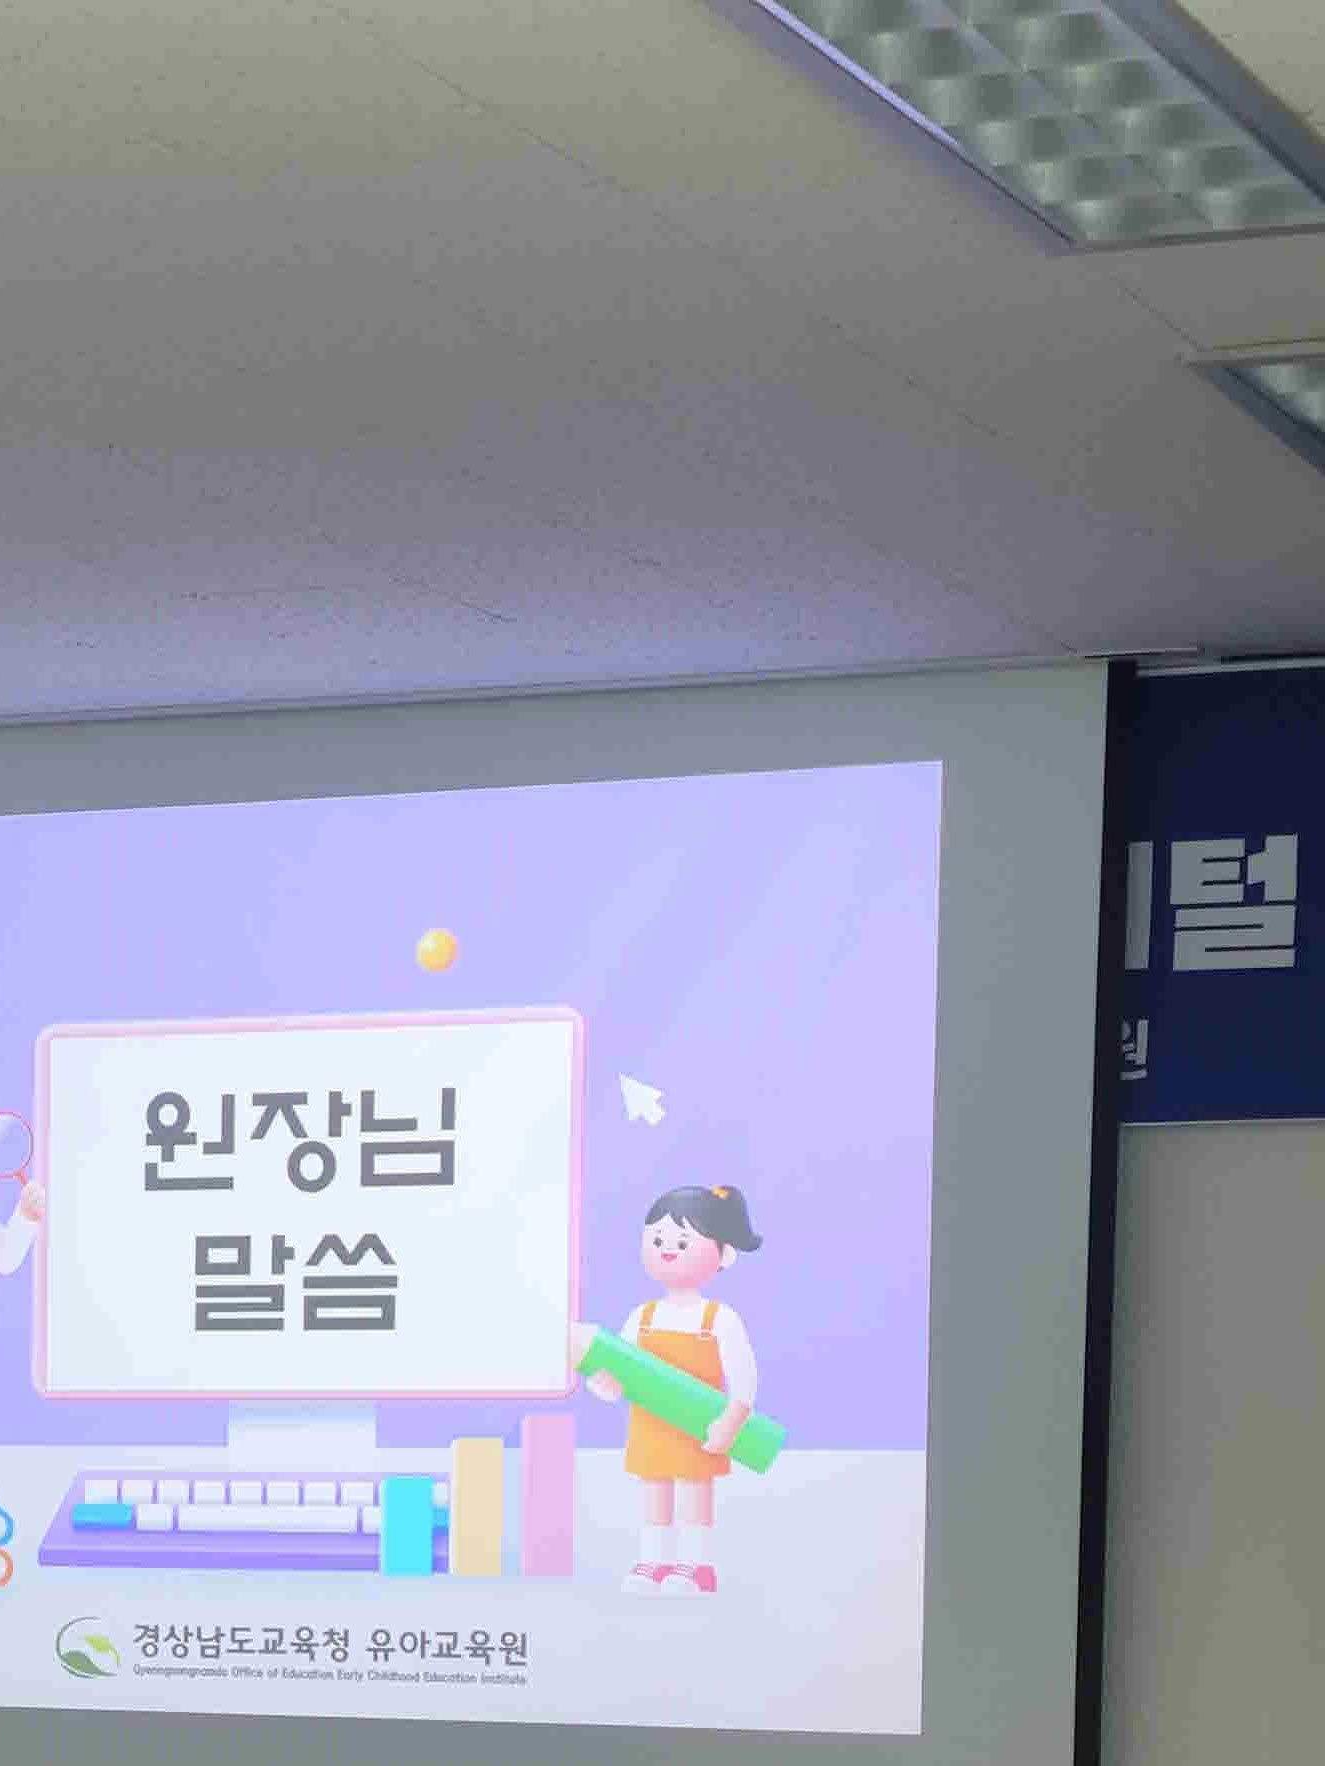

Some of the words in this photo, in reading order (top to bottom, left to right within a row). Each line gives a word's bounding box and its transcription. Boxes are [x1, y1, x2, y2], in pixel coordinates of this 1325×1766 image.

[144, 1087, 457, 1193] 원장님
[195, 1233, 398, 1331] 말씀
[134, 1624, 350, 1663] 경상남도교육청
[366, 1628, 528, 1666] 유아교육원
